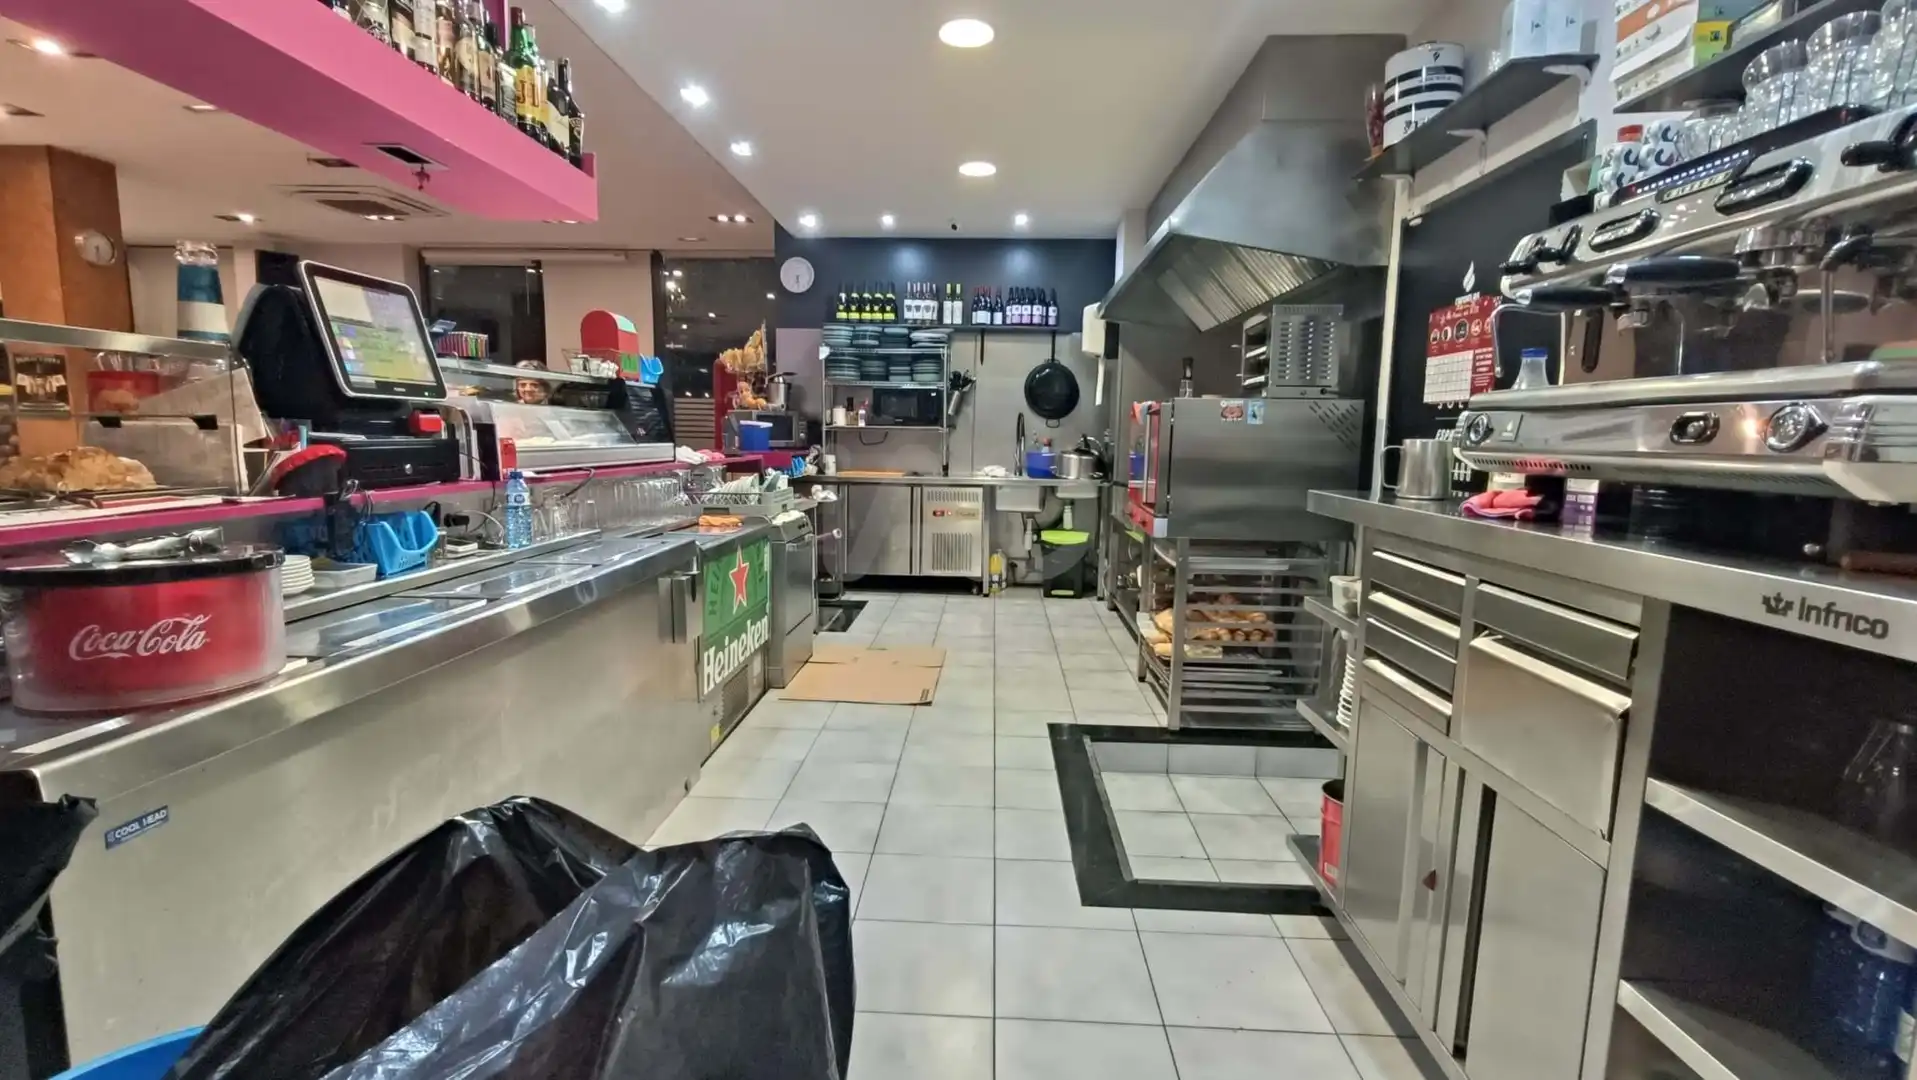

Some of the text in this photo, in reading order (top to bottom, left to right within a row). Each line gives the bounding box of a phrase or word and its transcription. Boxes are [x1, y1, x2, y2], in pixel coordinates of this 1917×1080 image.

[68, 613, 212, 661] Coca-Cola
[1798, 597, 1889, 640] Infrico
[703, 615, 768, 695] Heineken
[115, 822, 140, 838] COOL
